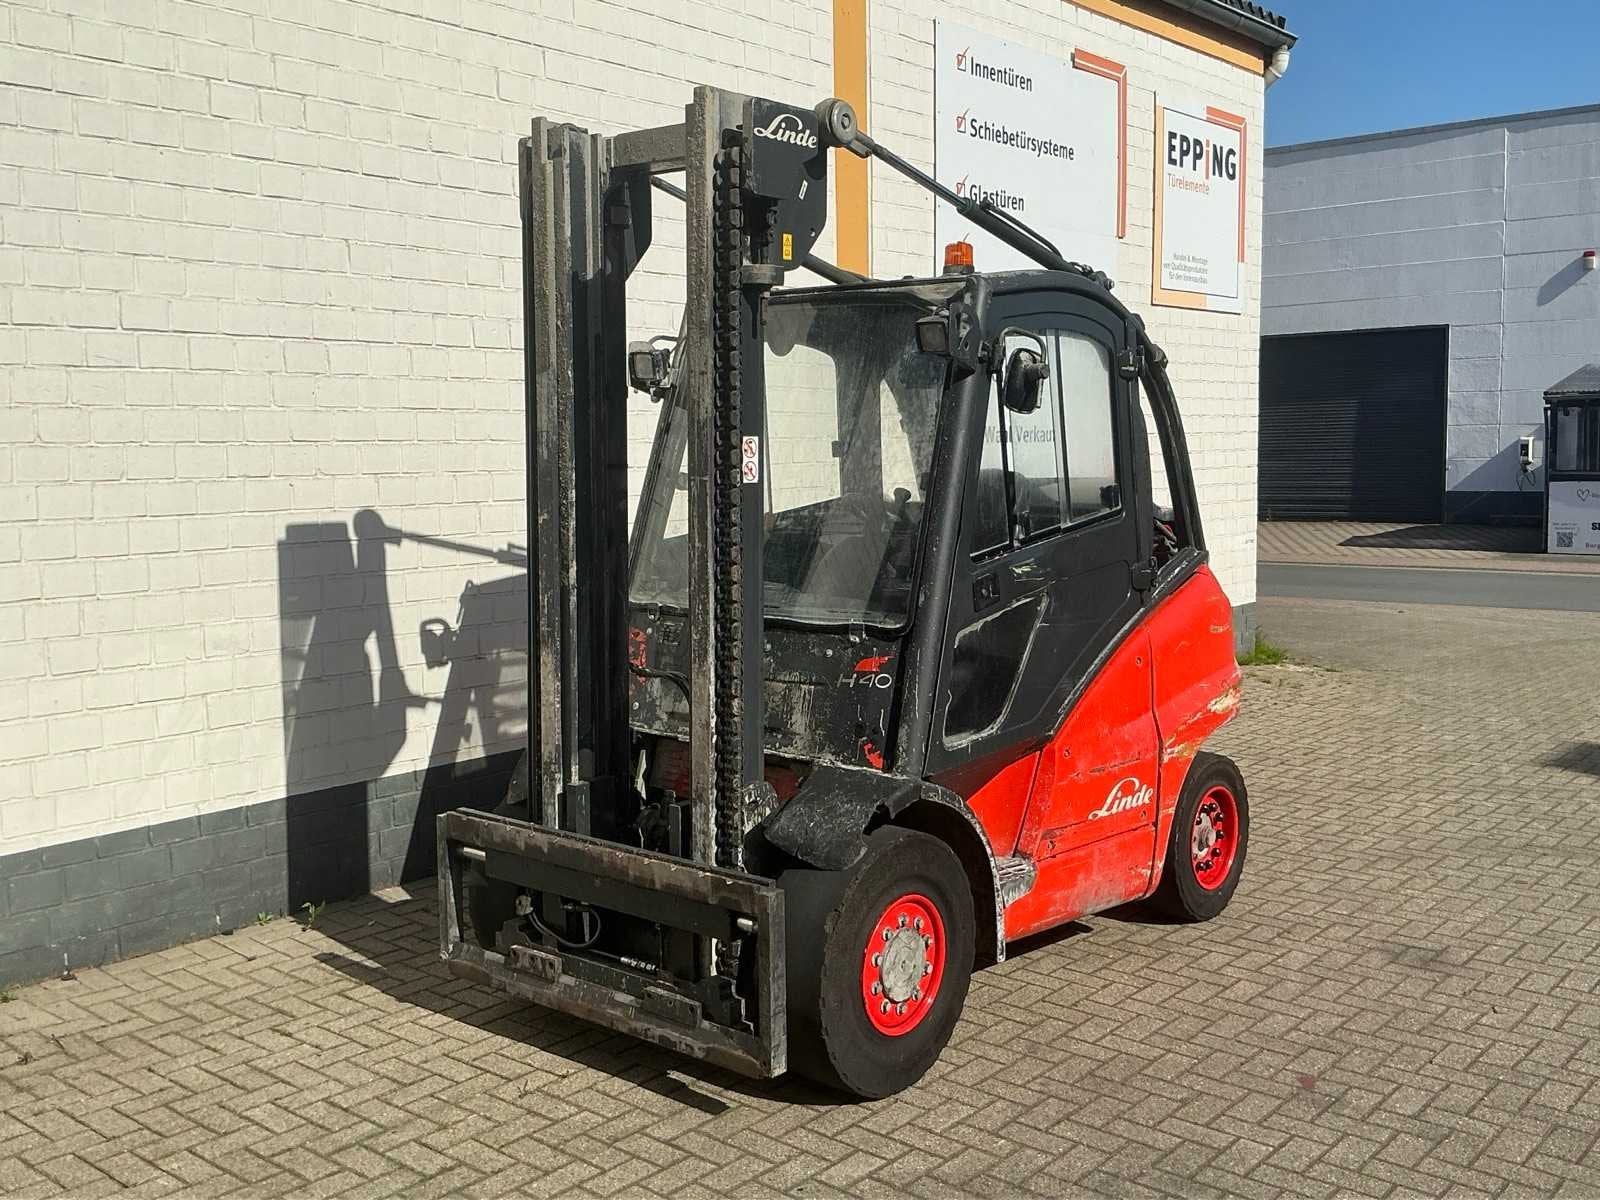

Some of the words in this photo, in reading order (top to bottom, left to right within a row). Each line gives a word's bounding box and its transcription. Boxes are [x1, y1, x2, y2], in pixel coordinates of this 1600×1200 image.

[971, 57, 1032, 91] Innentüren
[753, 113, 817, 149] Linde
[970, 118, 1074, 160] Schiebetürsysteme
[969, 184, 1025, 211] Glastüren
[1167, 173, 1209, 195] Türelemente
[1087, 777, 1154, 821] Linde
